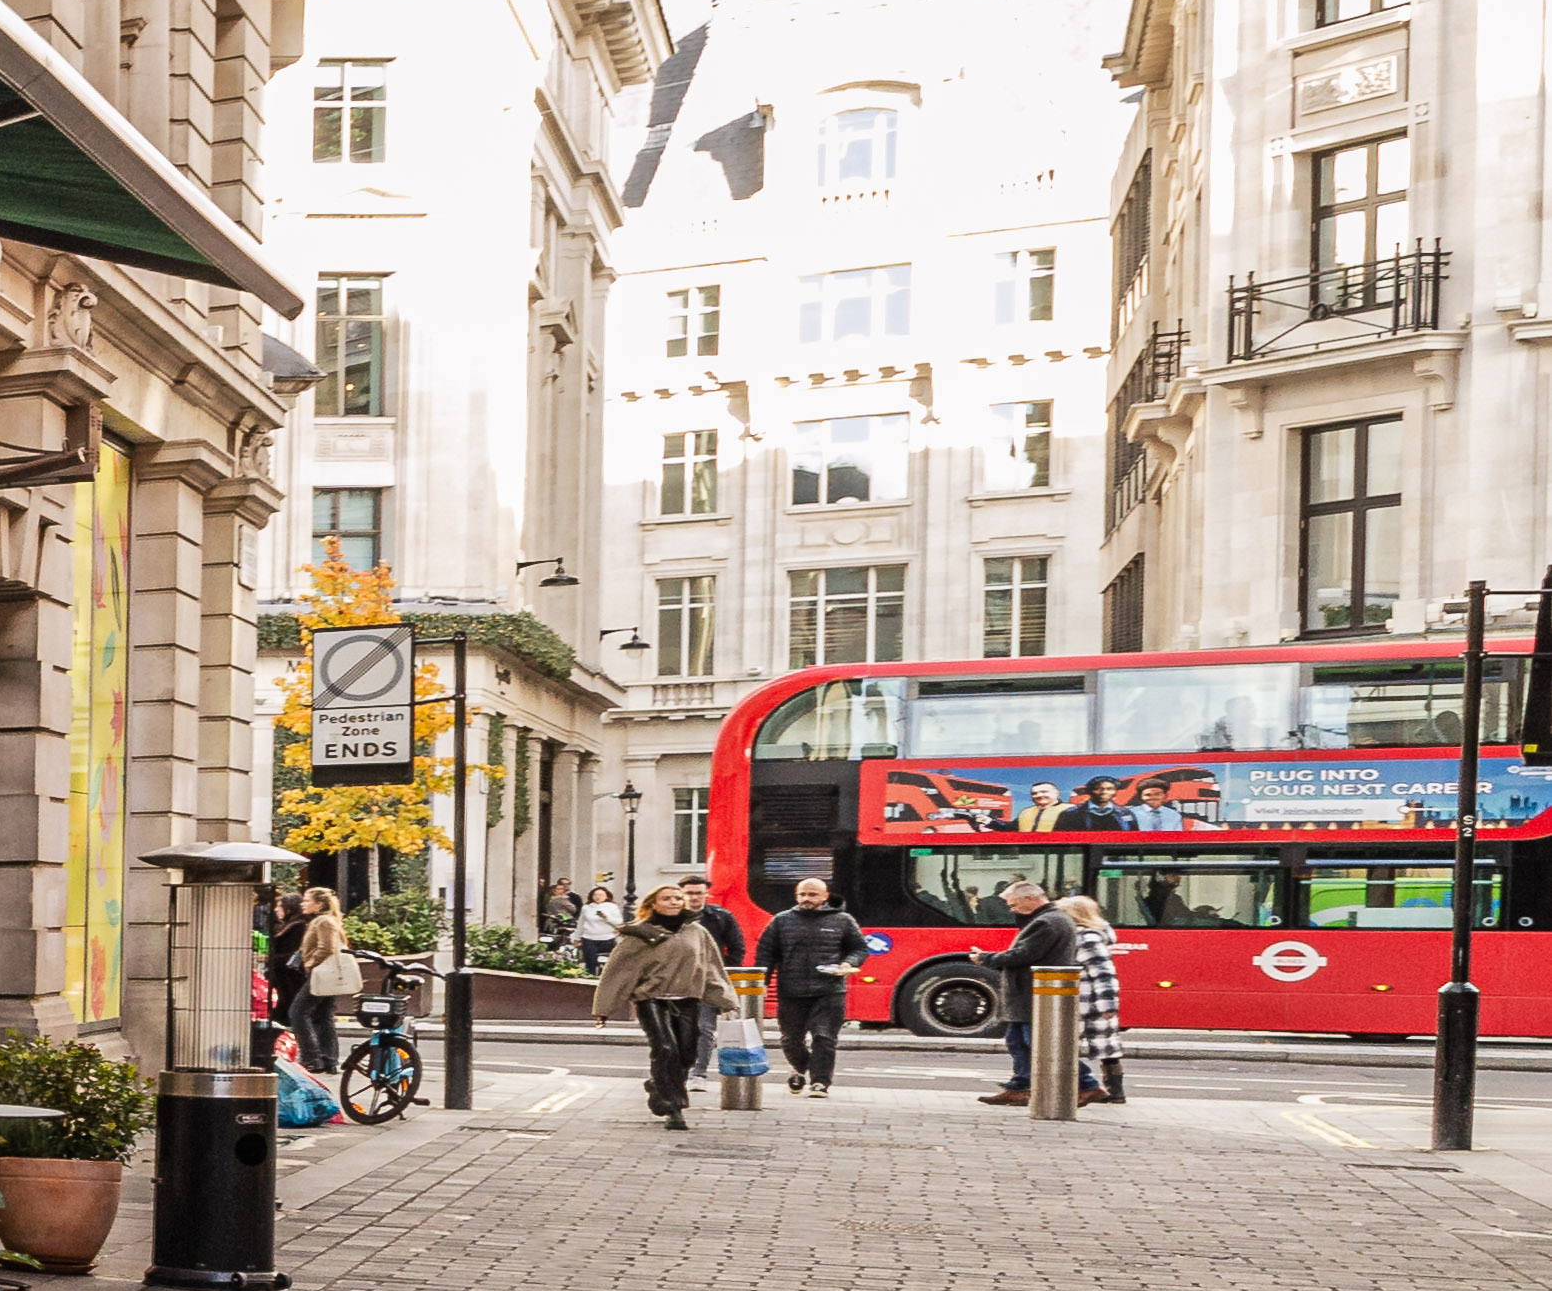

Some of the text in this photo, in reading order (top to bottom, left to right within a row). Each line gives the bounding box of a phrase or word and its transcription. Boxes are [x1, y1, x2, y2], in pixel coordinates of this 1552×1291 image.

[318, 712, 404, 724] Pedestrian
[342, 726, 380, 737] Zone
[325, 741, 397, 759] ENDS
[1249, 768, 1380, 782] PLUG INTO
[1249, 781, 1493, 796] YOUR NEXT CARER
[1463, 814, 1474, 826] S
[1462, 827, 1473, 838] 2
